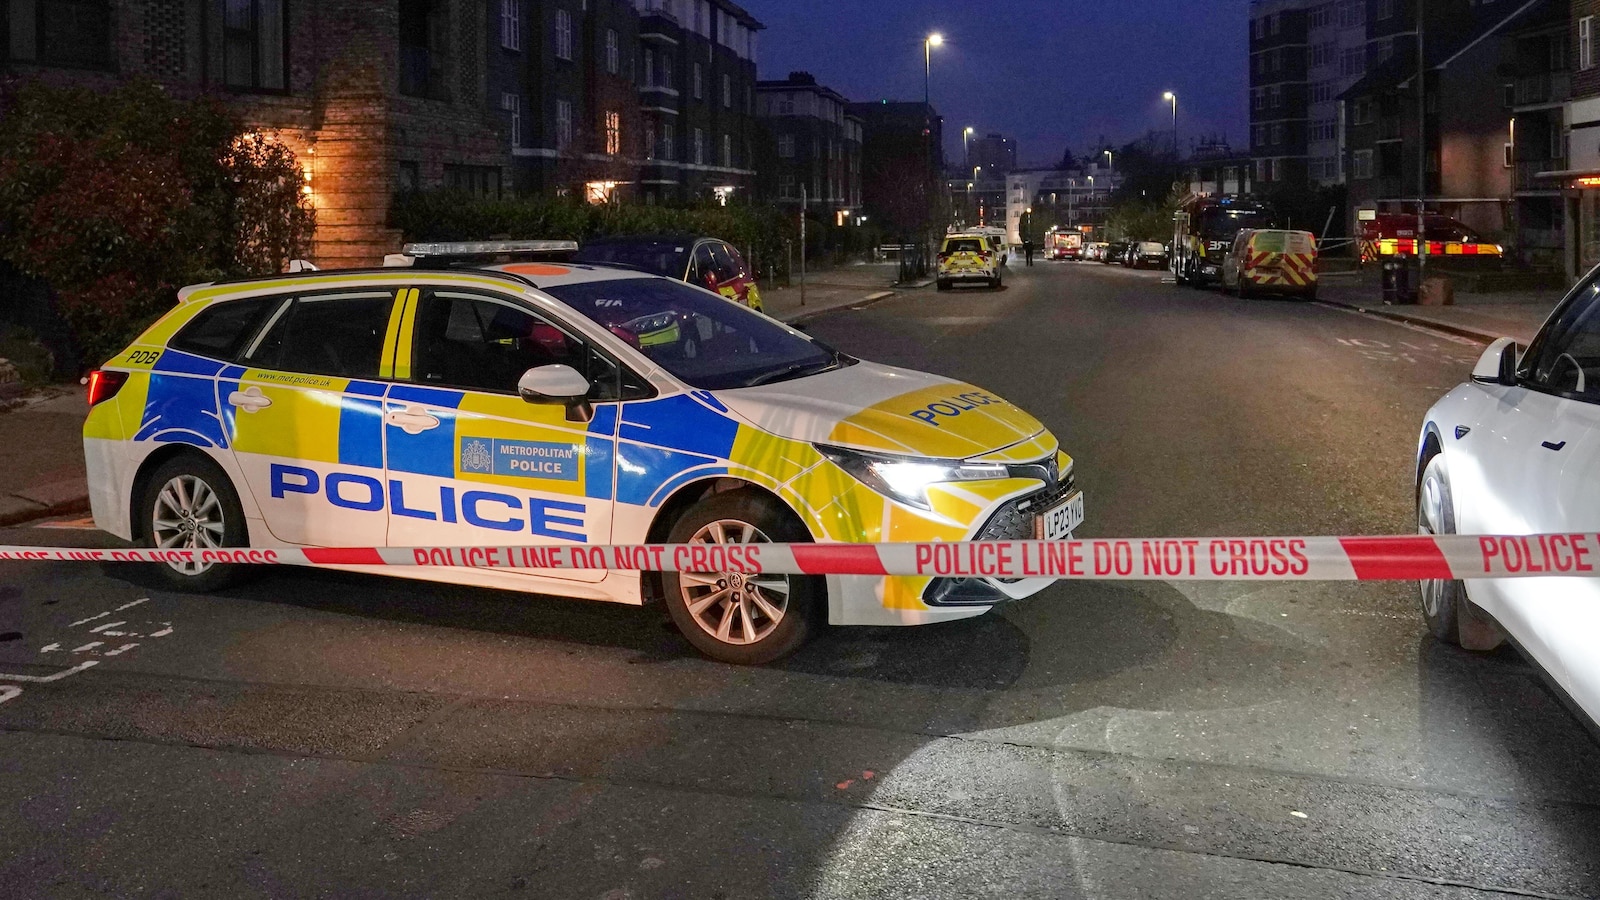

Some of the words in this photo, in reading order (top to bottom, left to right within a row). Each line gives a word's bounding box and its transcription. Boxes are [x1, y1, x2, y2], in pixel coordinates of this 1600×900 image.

[126, 350, 160, 364] PDB
[257, 372, 332, 387] www.met.police.uk
[909, 392, 1001, 426] POLICE
[500, 445, 573, 459] METROPOLITAN
[510, 459, 562, 473] POLICE
[270, 463, 588, 543] POLICE
[1048, 506, 1069, 538] LP23
[614, 546, 666, 571] NOT
[674, 545, 763, 574] CROSS
[916, 541, 1013, 575] POLICE
[1022, 541, 1084, 576] LINE
[1094, 541, 1132, 576] DO
[1143, 540, 1200, 576] NOT
[1209, 539, 1309, 576] CROSS
[1479, 534, 1593, 572] POLICE
